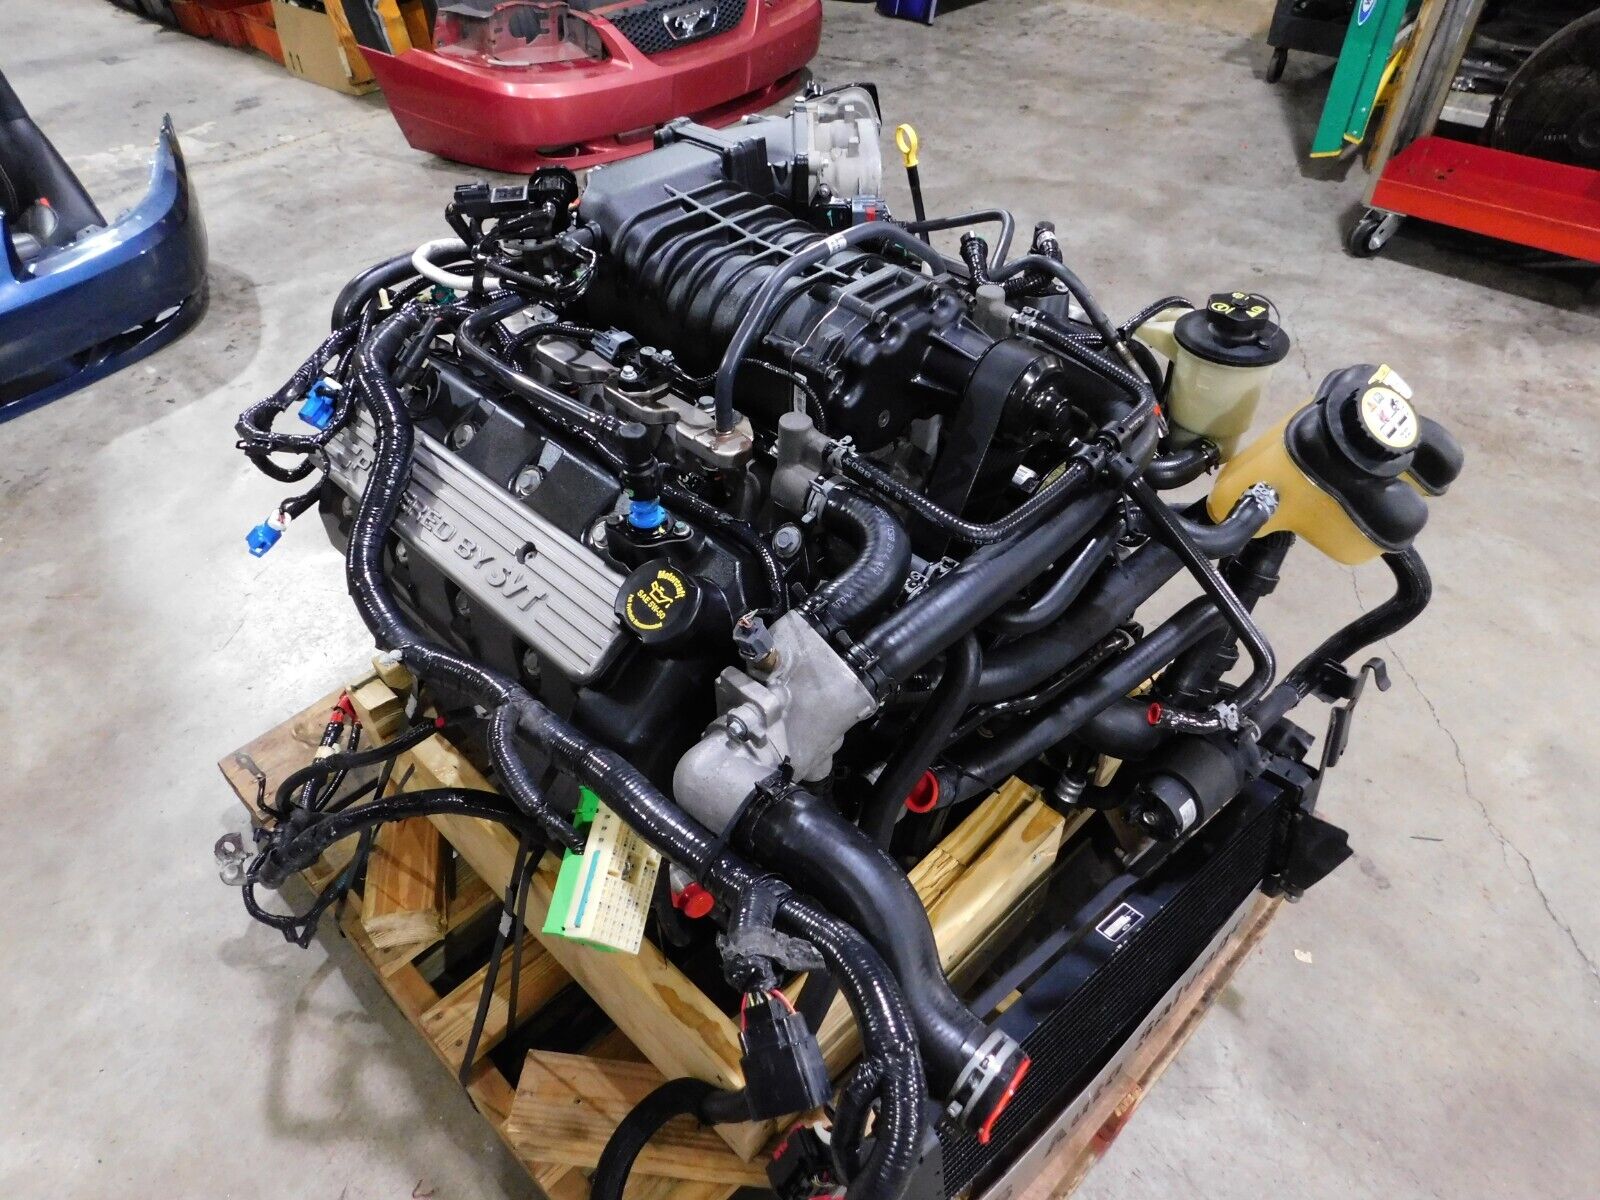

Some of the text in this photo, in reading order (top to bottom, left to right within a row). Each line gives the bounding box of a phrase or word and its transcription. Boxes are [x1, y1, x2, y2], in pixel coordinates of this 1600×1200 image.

[453, 537, 496, 570] BY
[485, 566, 549, 612] SVT
[657, 570, 686, 599] Motorcraft
[637, 589, 652, 604] SAE
[648, 601, 666, 619] 5W-50
